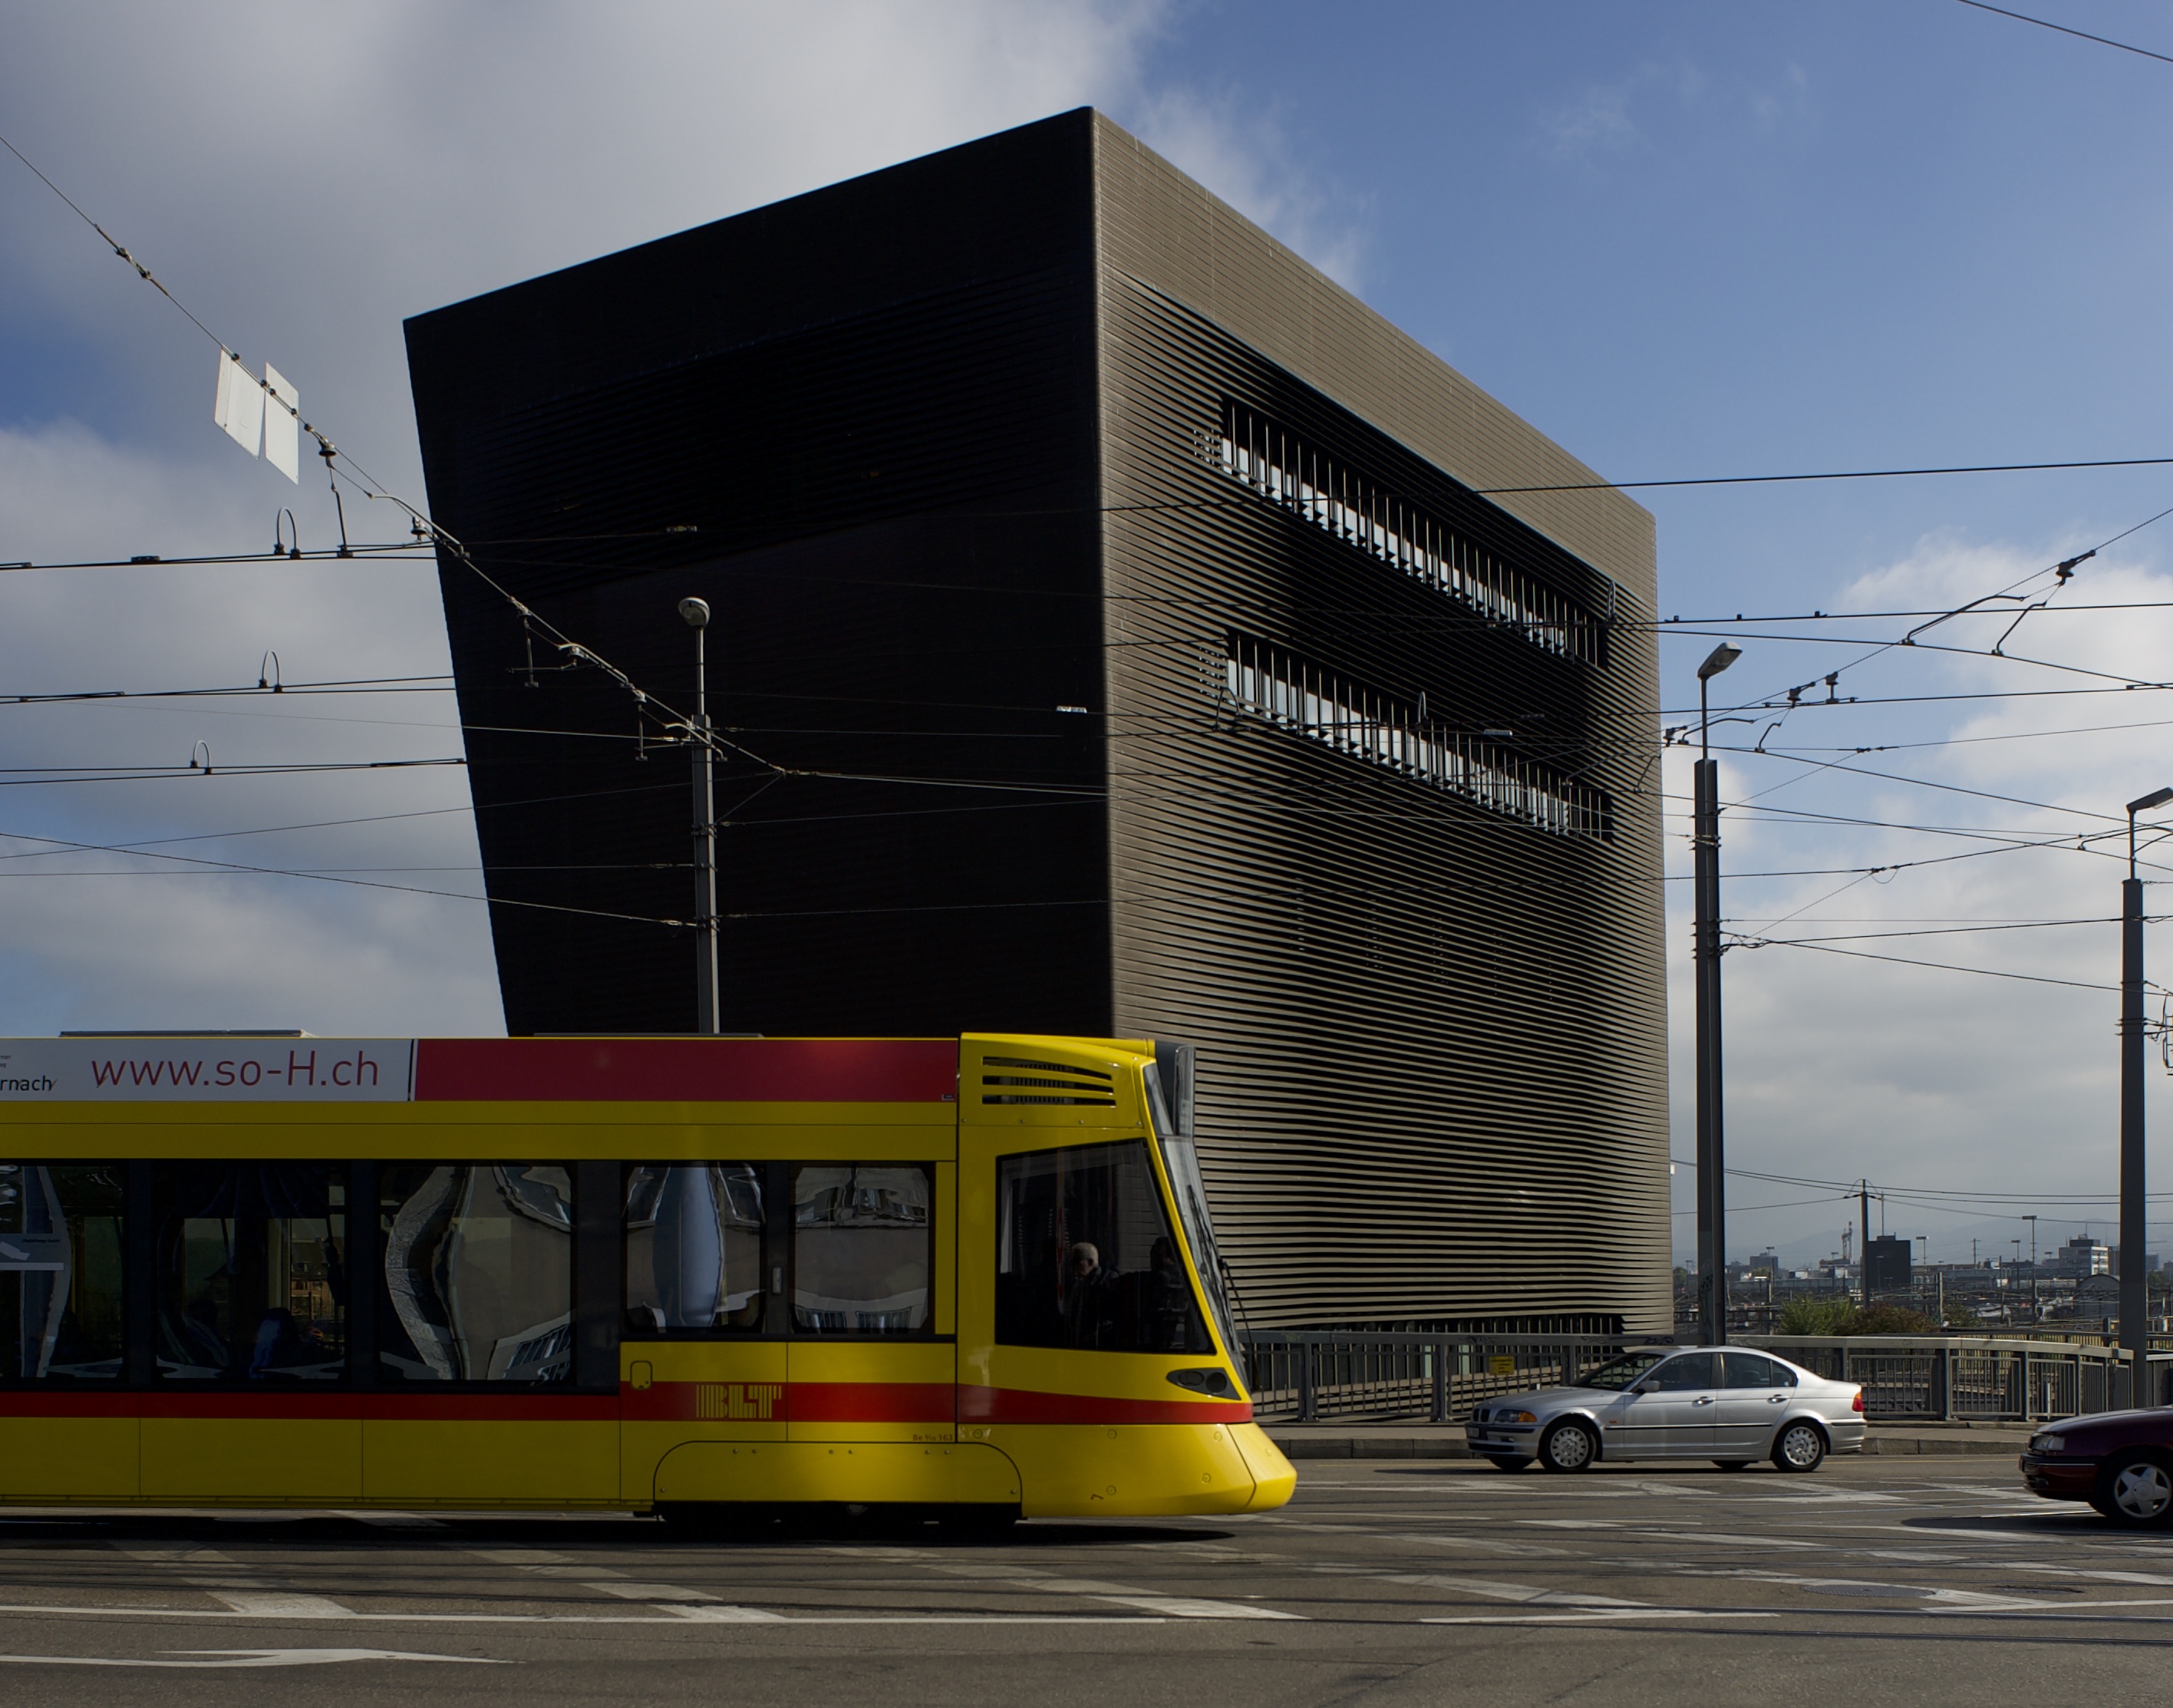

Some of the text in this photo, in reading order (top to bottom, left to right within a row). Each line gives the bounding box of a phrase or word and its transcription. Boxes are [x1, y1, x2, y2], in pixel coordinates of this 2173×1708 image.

[0, 1075, 52, 1091] rnach
[91, 1050, 379, 1086] www.so-H.ch
[696, 1384, 782, 1419] BLT
